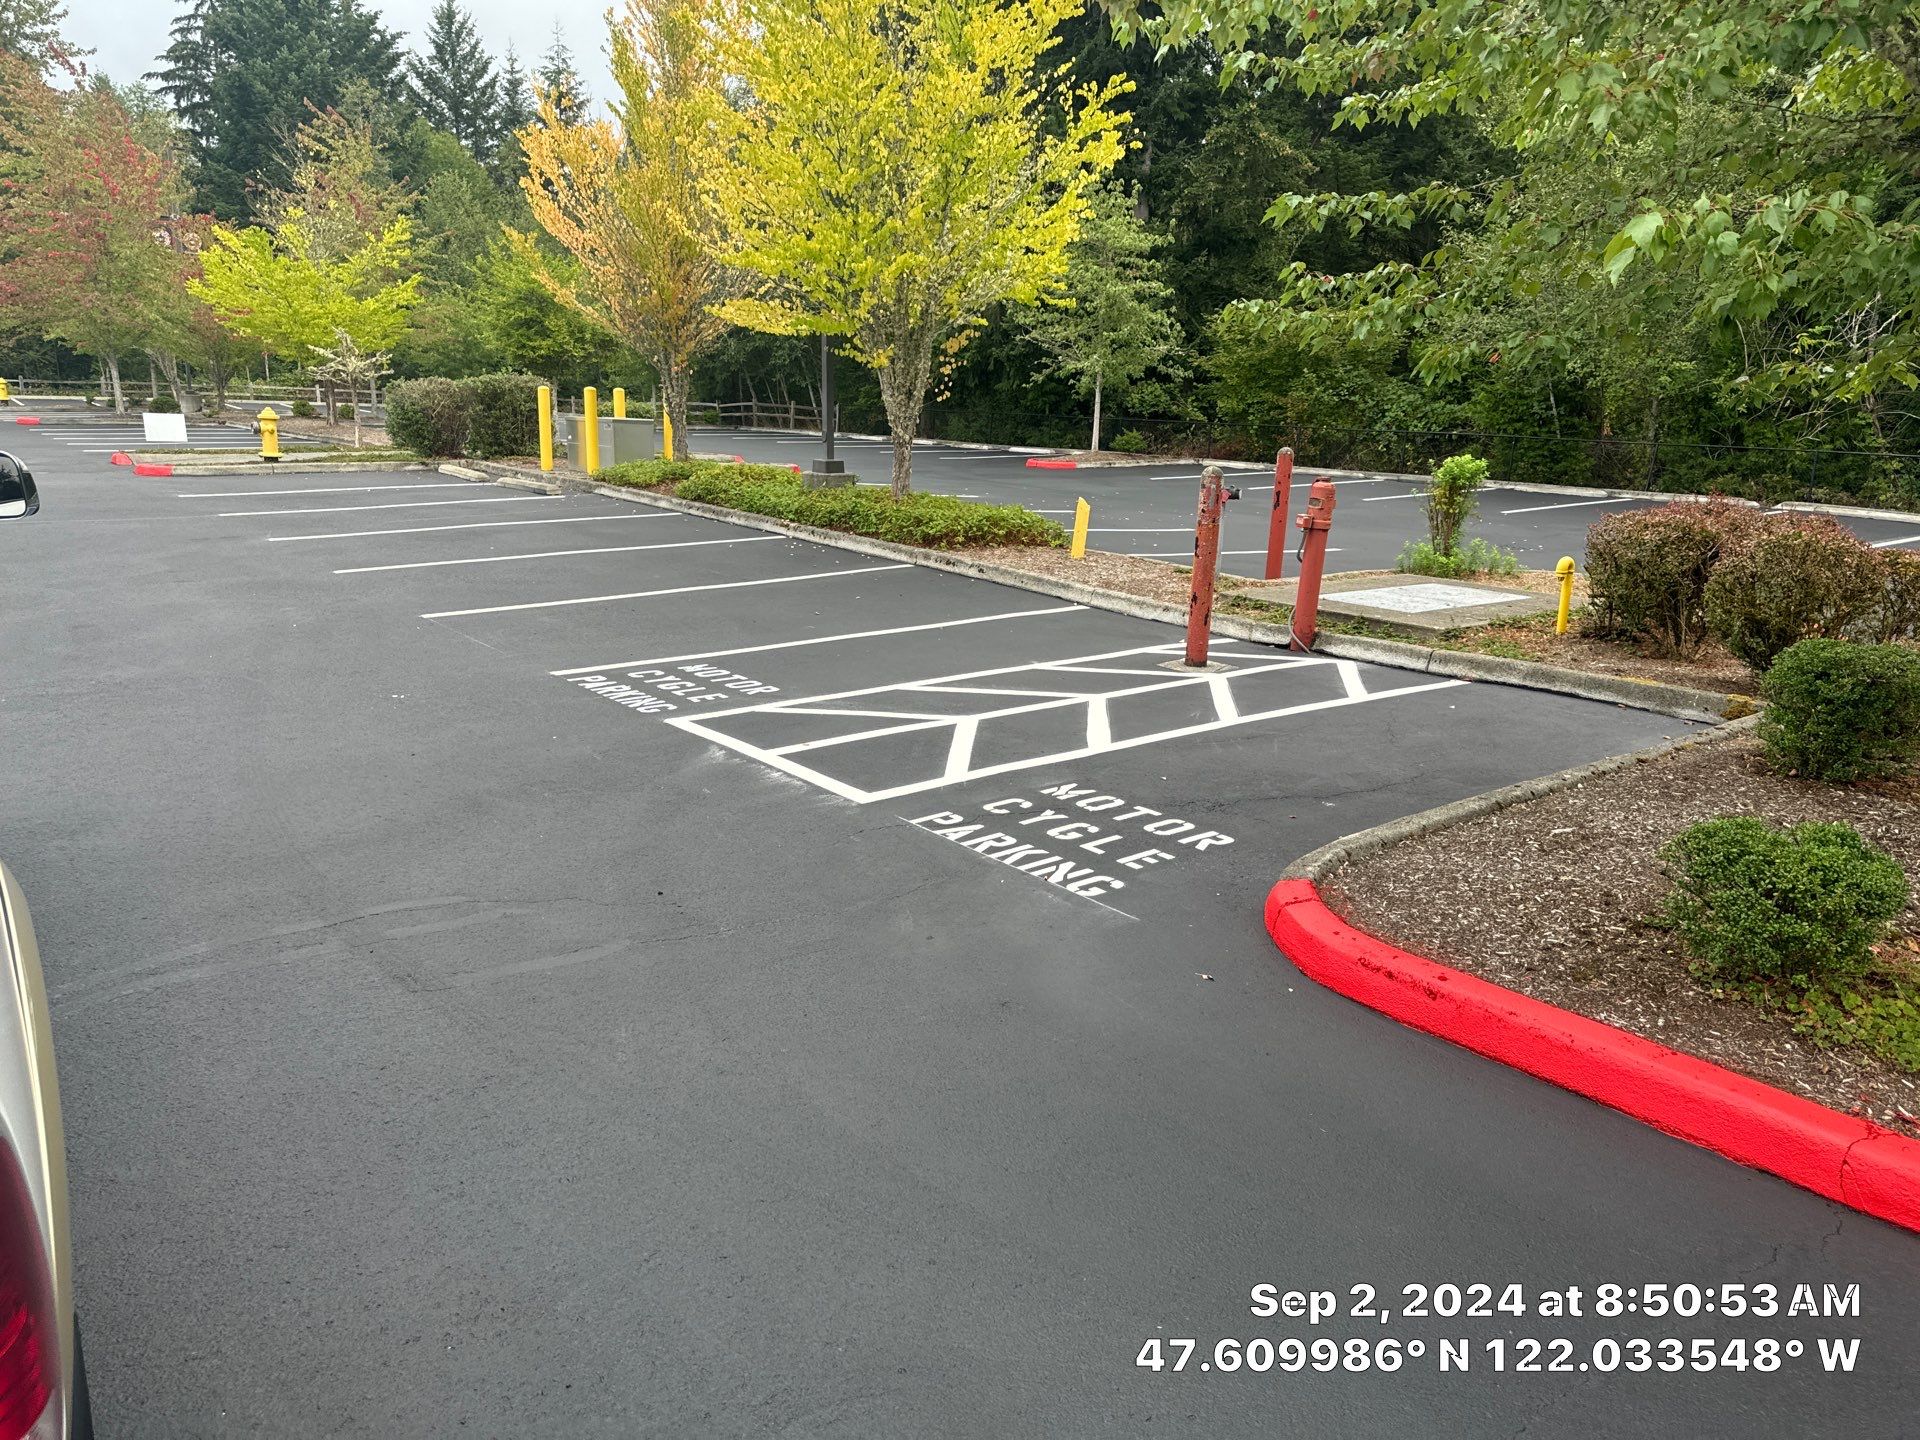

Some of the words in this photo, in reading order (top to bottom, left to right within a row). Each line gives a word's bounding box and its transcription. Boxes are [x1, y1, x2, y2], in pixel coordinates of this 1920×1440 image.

[566, 675, 678, 714] PARKING
[677, 663, 781, 696] MOTOR
[1040, 782, 1236, 851] MOTOR
[909, 811, 1126, 897] PARKING
